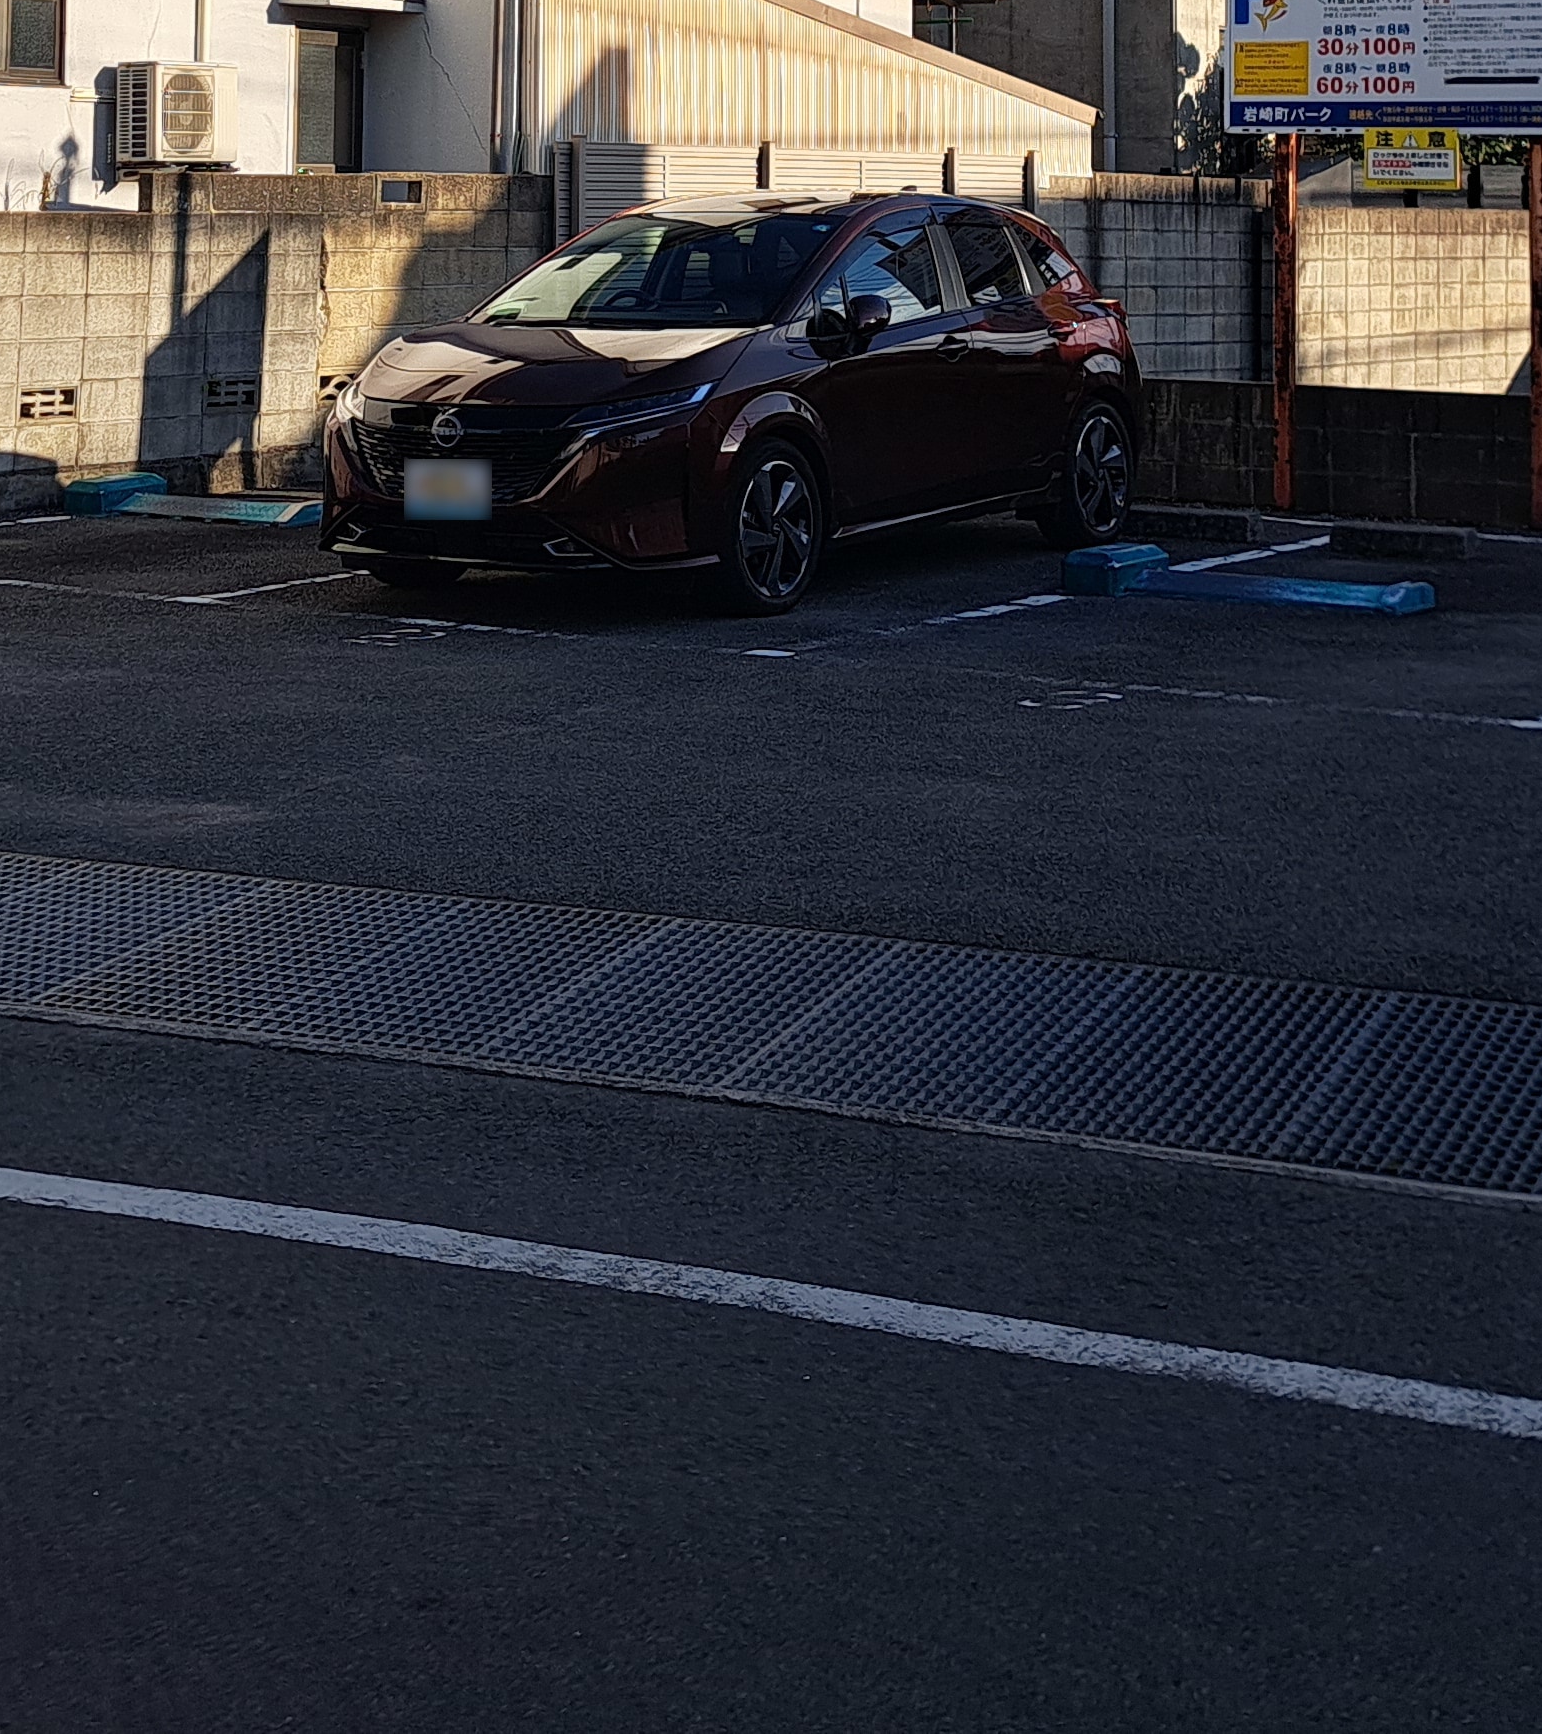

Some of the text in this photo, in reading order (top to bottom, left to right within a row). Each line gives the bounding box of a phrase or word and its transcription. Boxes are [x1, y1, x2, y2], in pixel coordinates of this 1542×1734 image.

[1243, 105, 1332, 123] 岩崎町パーク
